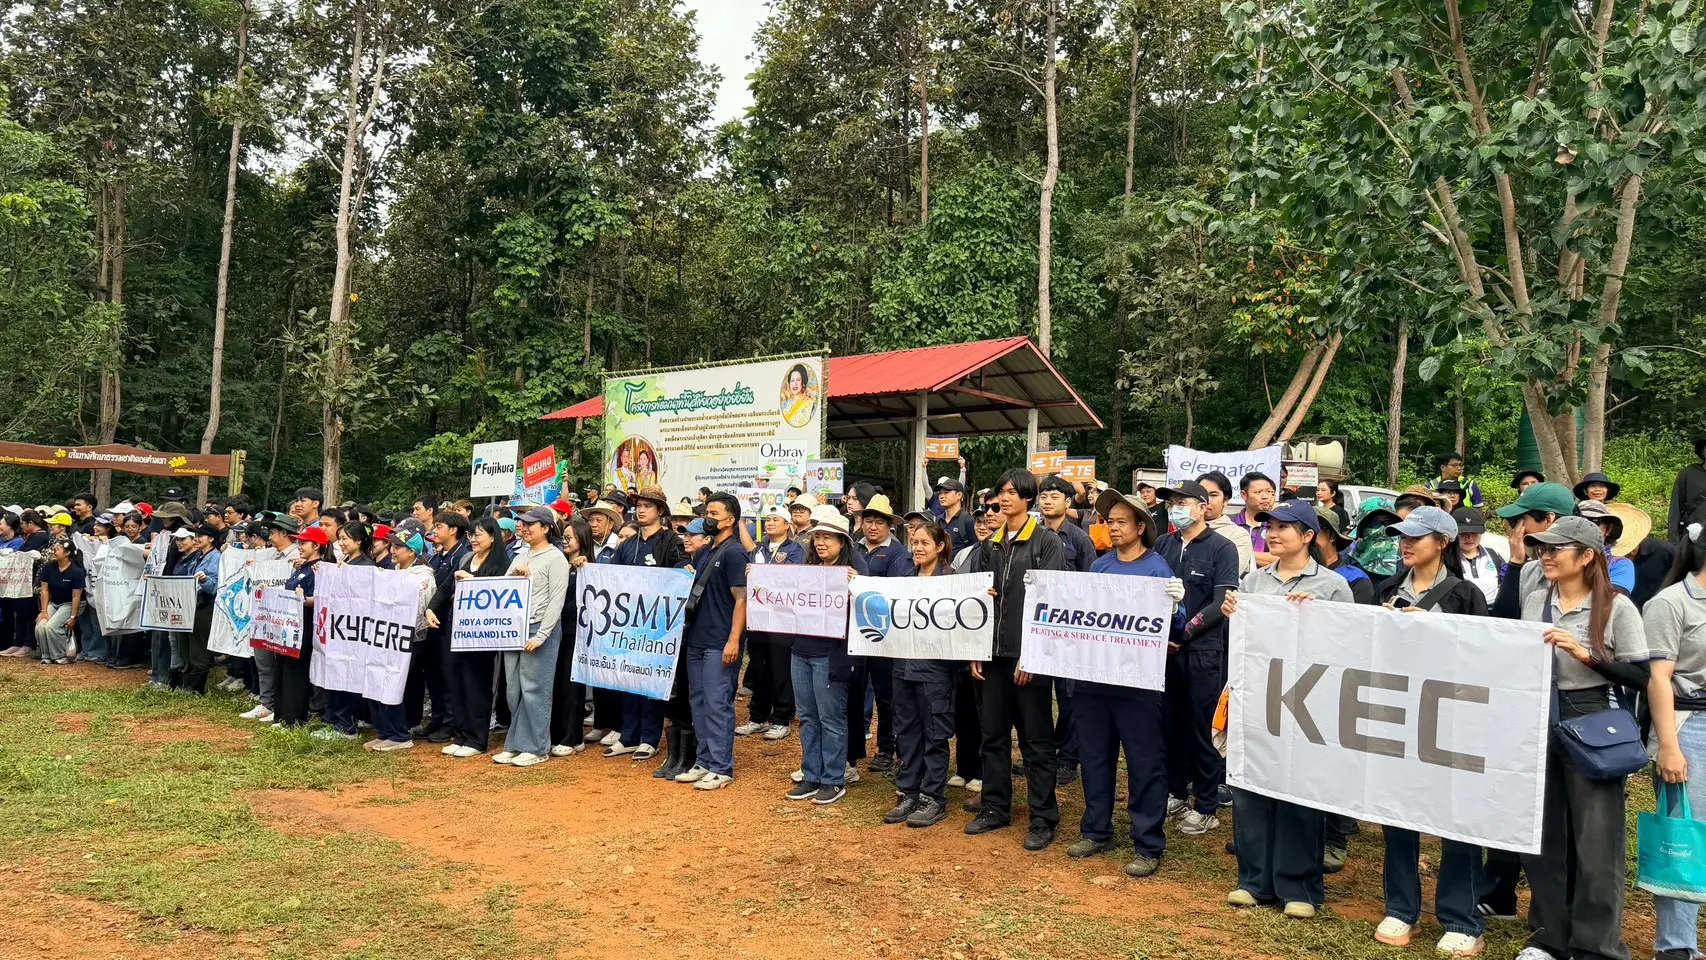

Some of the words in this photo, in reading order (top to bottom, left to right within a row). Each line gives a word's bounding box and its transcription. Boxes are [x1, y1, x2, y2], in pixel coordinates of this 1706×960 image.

[761, 442, 805, 459] Orbray
[941, 443, 956, 453] TE
[482, 461, 514, 476] Fujikura
[807, 469, 817, 477] WE
[1076, 465, 1093, 476] TE
[1180, 458, 1265, 478] elematec
[457, 589, 523, 610] HOYA
[765, 591, 844, 609] KANSEIDO
[612, 592, 688, 631] SMV
[862, 593, 988, 631] GUSCO
[483, 618, 512, 626] OPTICS
[1048, 608, 1164, 634] FARSONICS
[453, 631, 500, 640] (THAILAND)
[501, 630, 521, 639] LTD.
[610, 631, 677, 656] Thailand
[1030, 627, 1062, 638] PLATING
[1063, 631, 1070, 639] &
[1071, 631, 1107, 643] SURFACE
[1109, 635, 1162, 648] TREATMENT
[655, 664, 673, 679] จำกั
[1266, 657, 1490, 774] KEC
